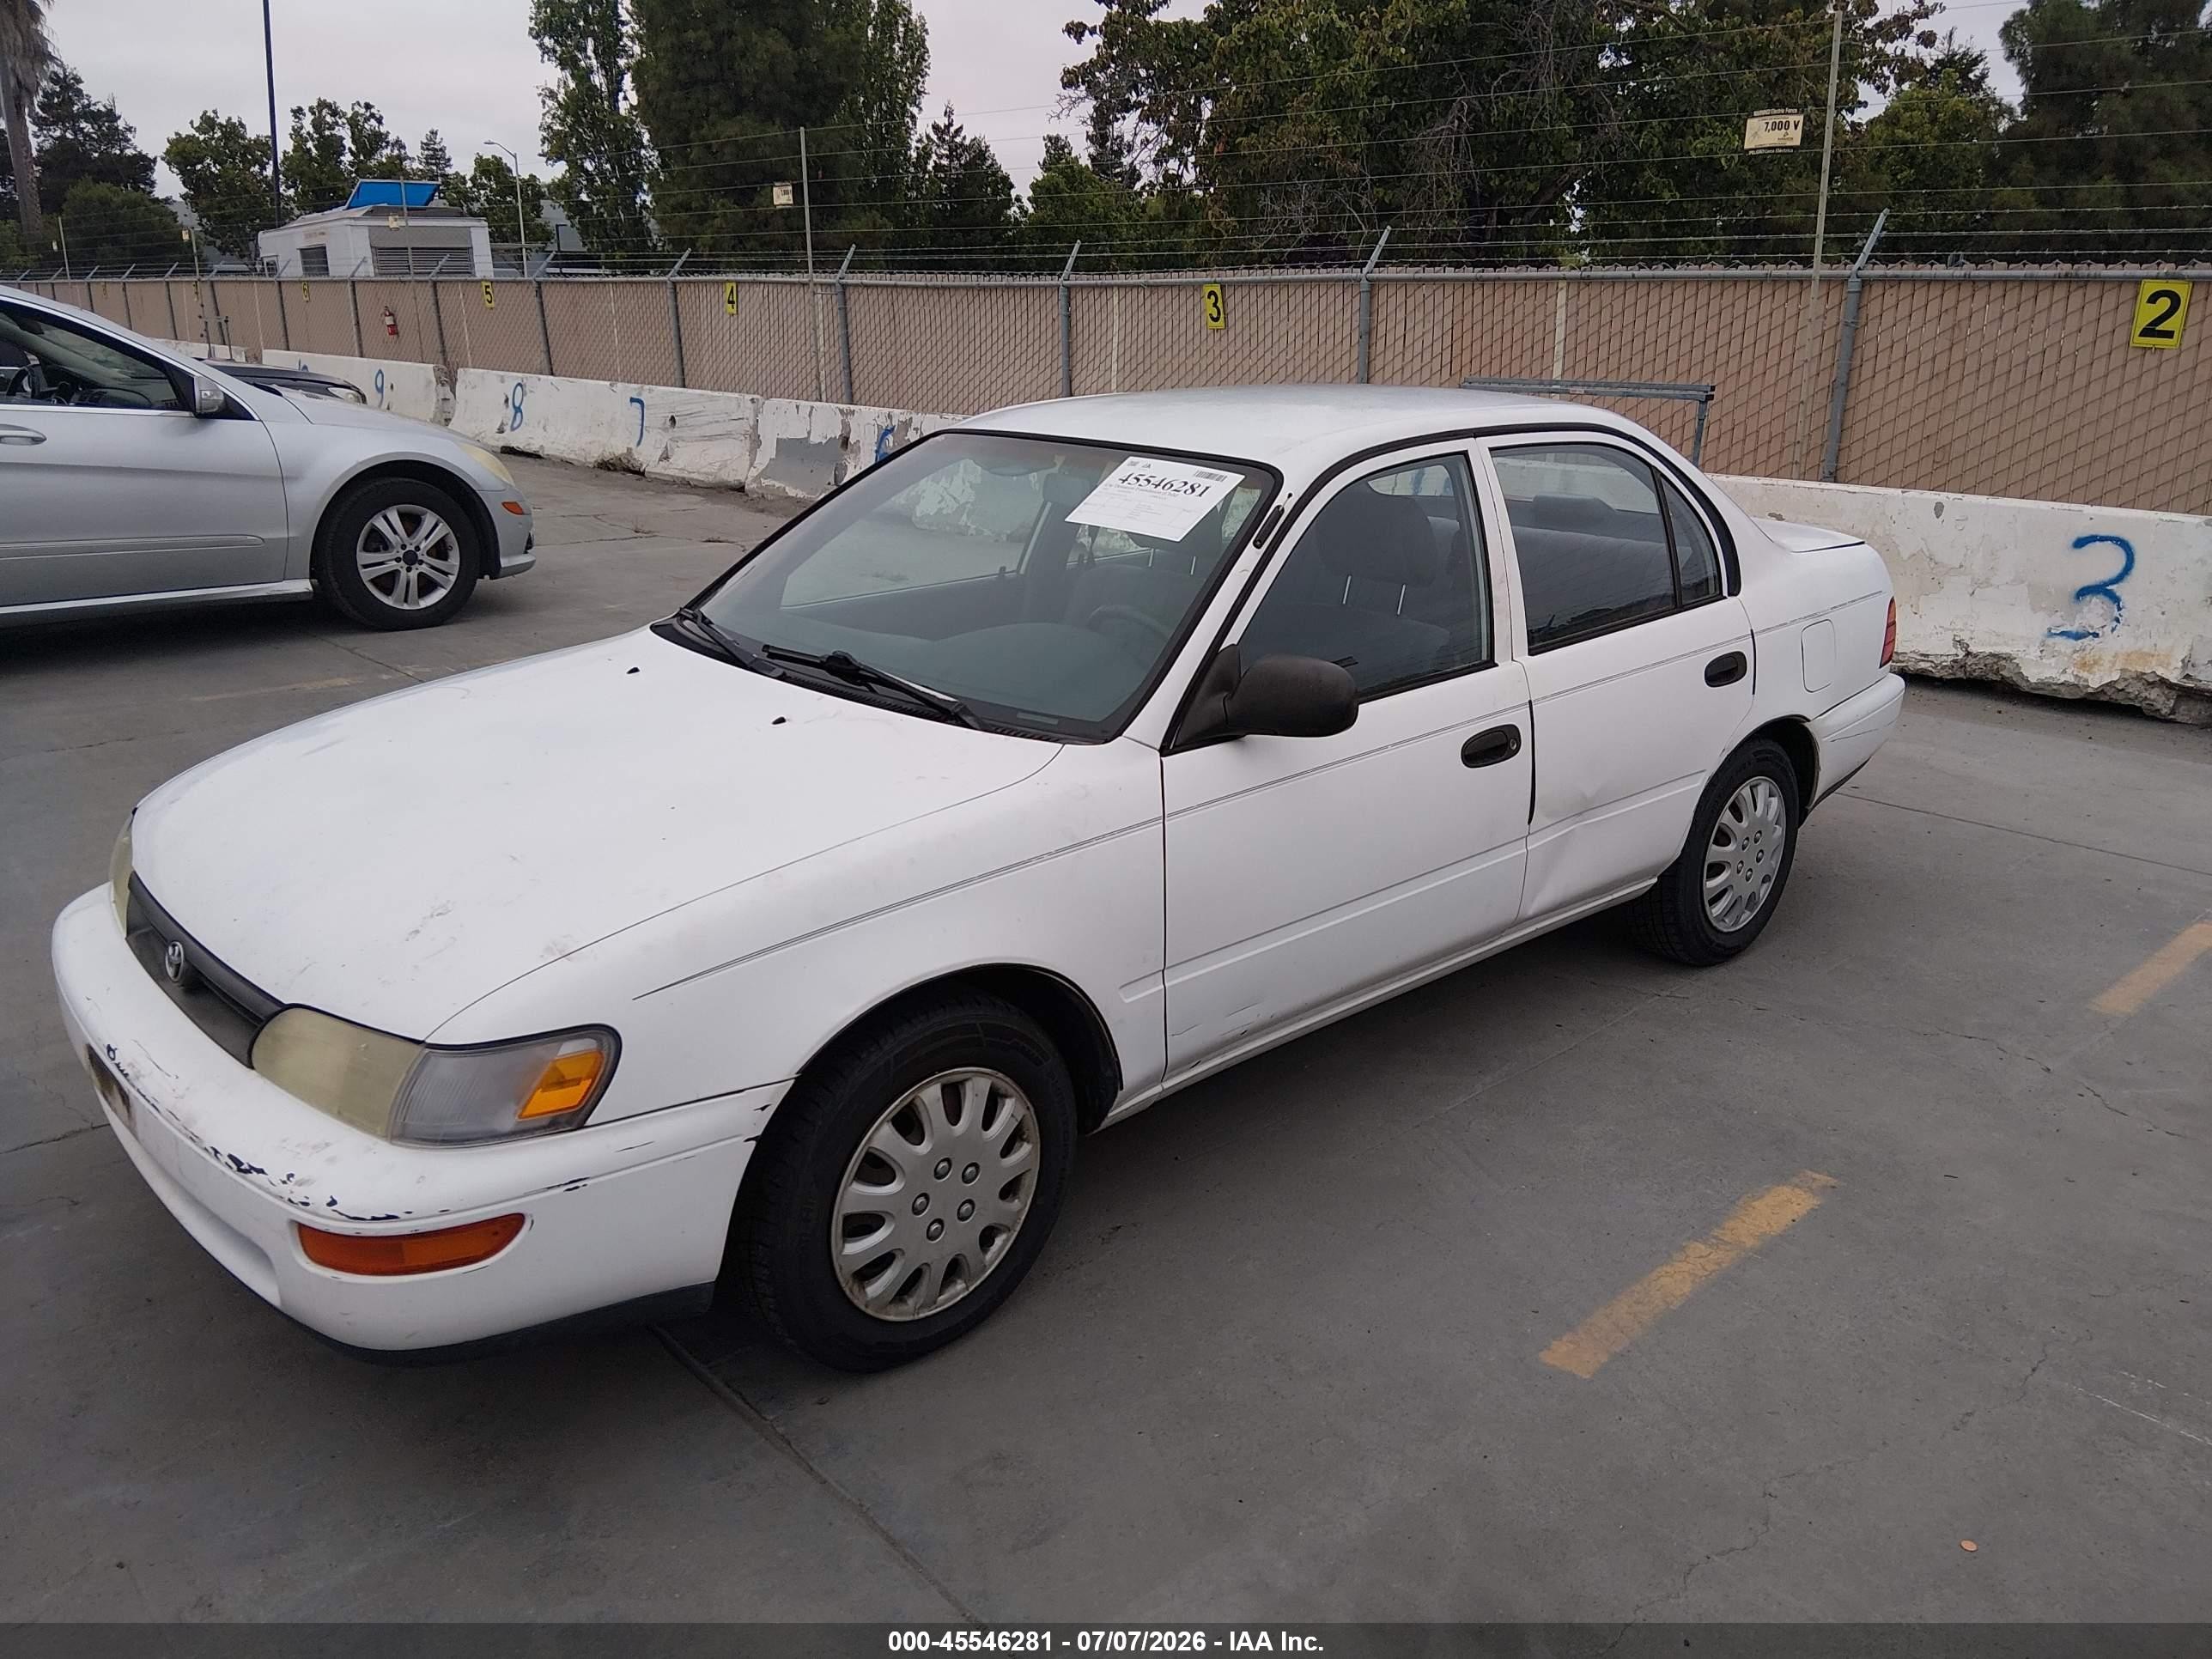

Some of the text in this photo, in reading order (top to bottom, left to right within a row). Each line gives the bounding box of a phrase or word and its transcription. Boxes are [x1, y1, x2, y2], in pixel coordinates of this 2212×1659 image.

[1765, 120, 1800, 133] 7,000 V
[484, 284, 493, 304] 5
[727, 285, 736, 310] 4
[1206, 290, 1221, 323] 3
[2138, 289, 2181, 339] 2
[374, 368, 385, 408] 9
[510, 382, 524, 431] 8
[629, 397, 645, 447] 7
[1118, 472, 1212, 498] 45546281
[2045, 534, 2136, 641] 3
